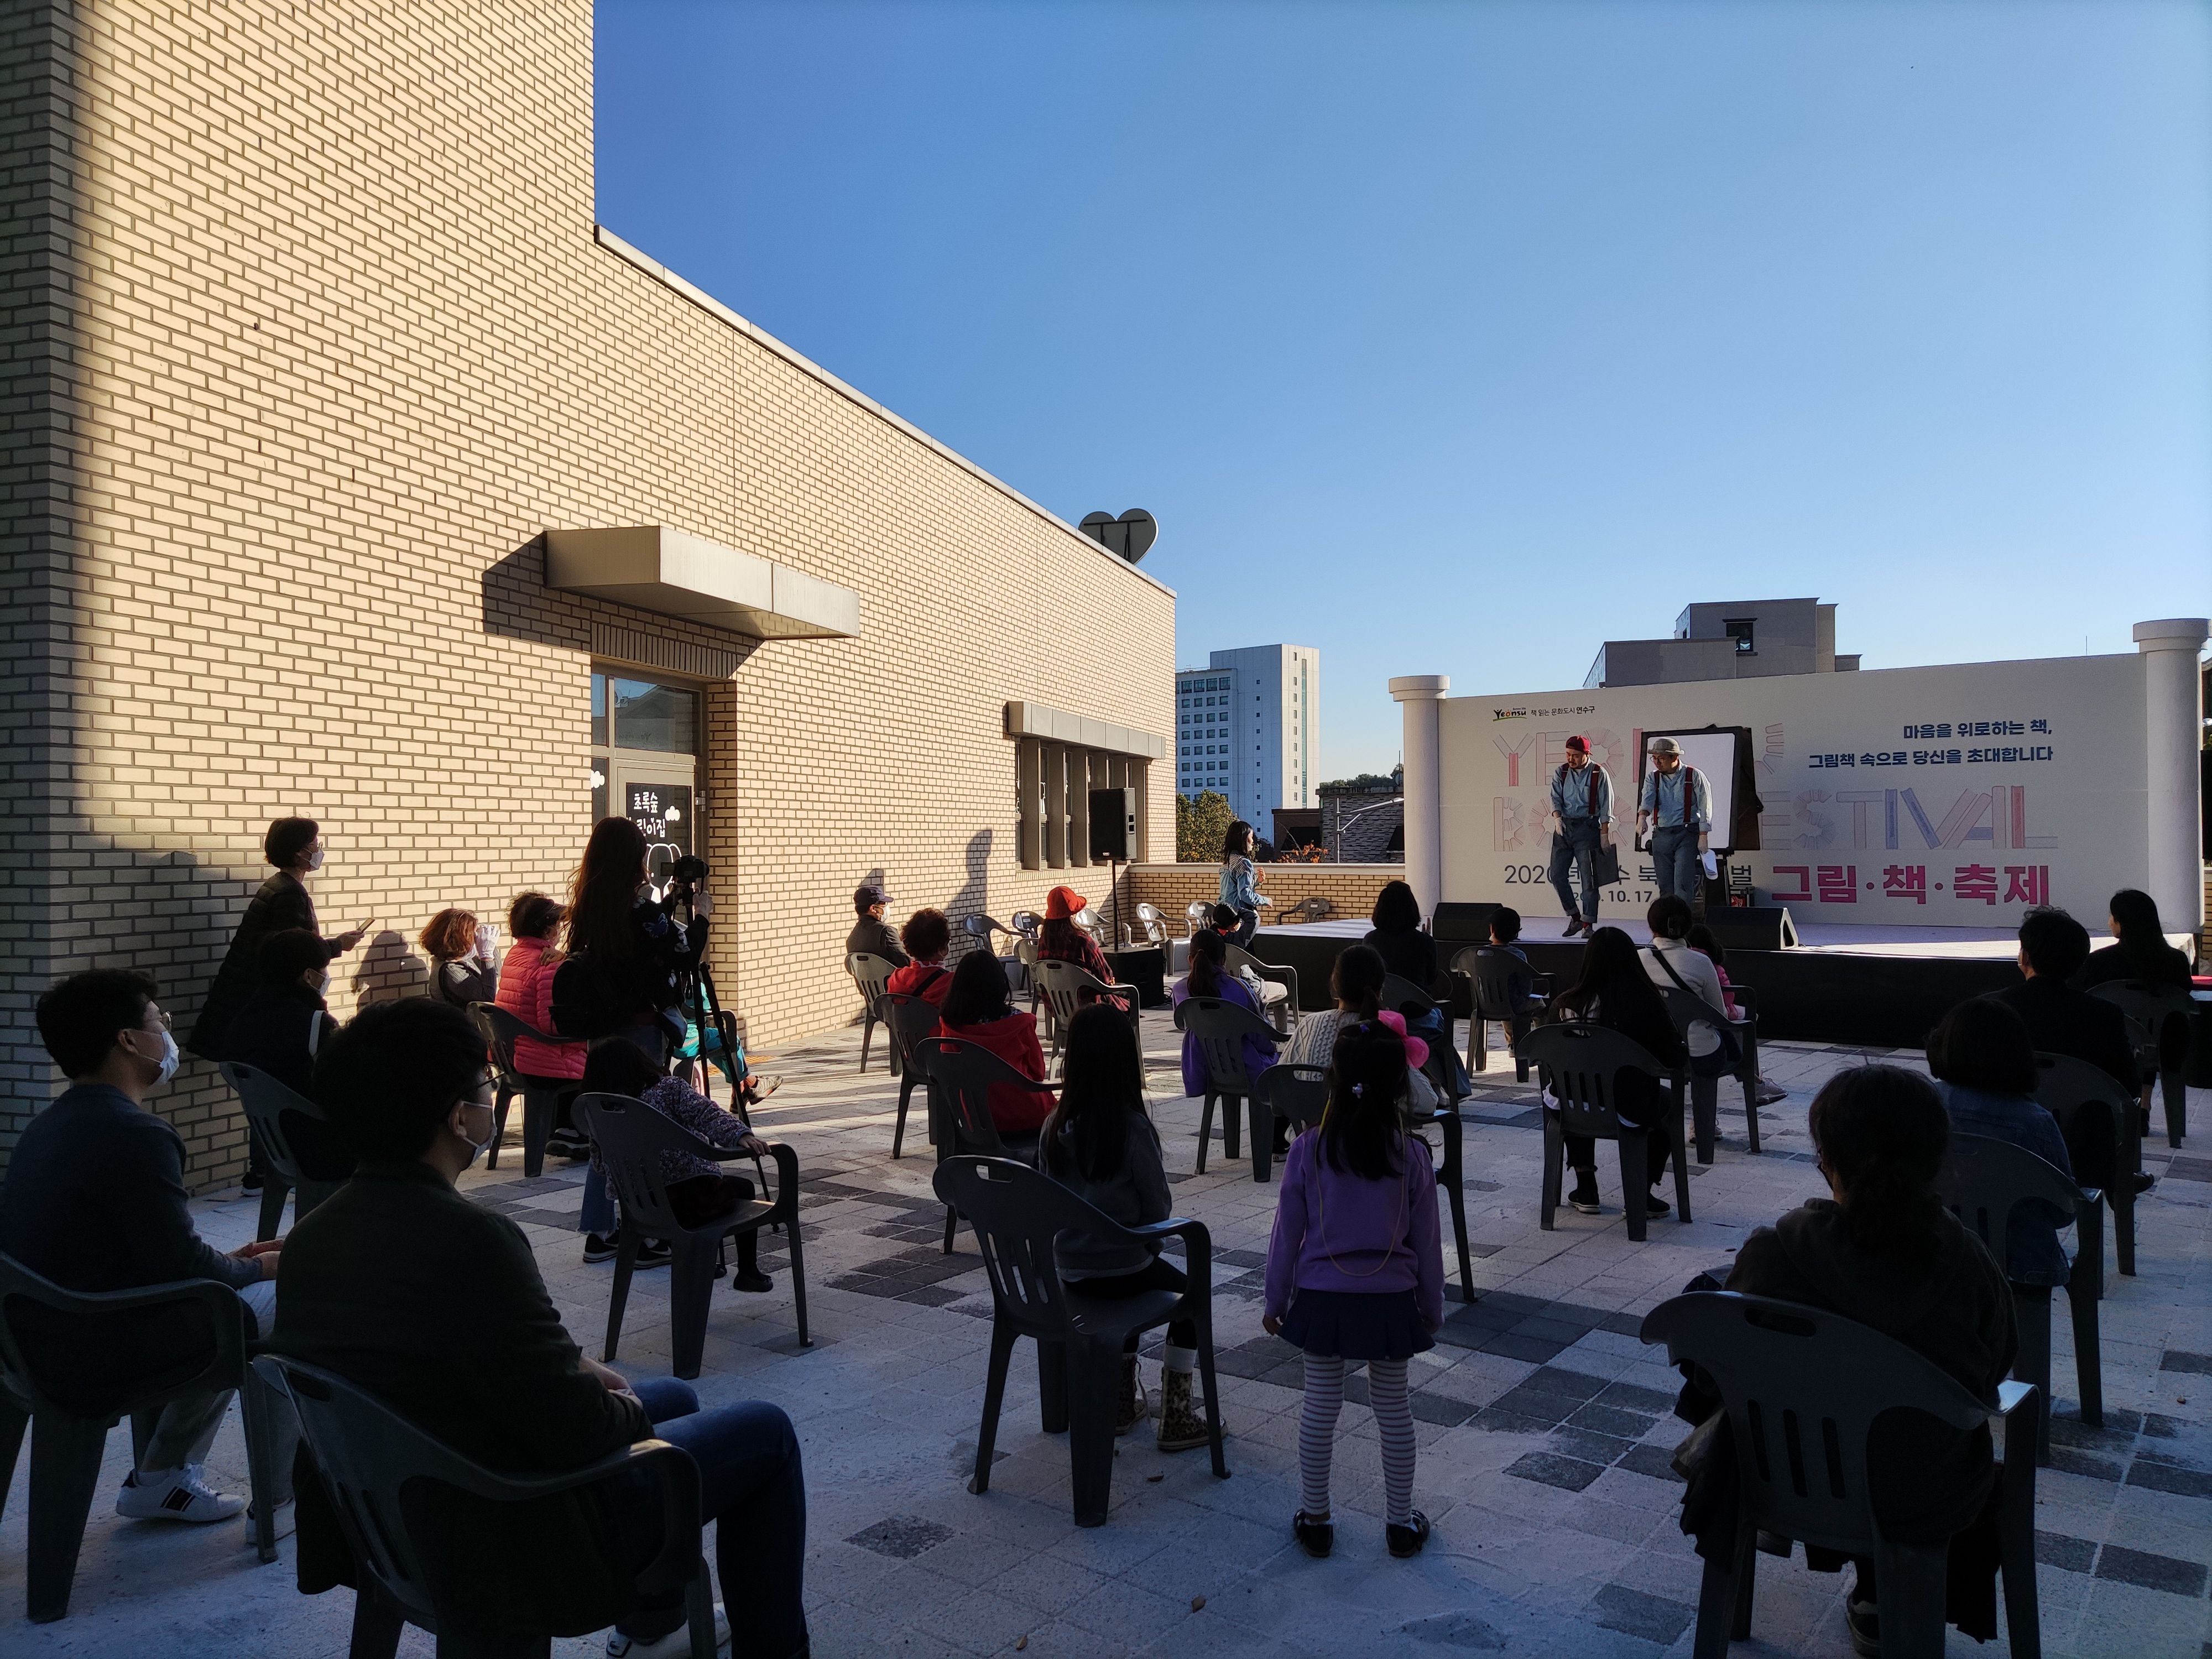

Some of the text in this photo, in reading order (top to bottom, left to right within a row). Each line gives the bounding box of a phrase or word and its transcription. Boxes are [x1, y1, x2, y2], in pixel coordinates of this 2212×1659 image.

[1493, 708, 1526, 720] Yeonsu
[1551, 707, 1575, 716] 문화도시
[1576, 706, 1595, 714] 연수구
[1904, 719, 2052, 739] 마음을 위로하는 책,
[1808, 746, 2053, 768] 그림책 속으로 당신을 초대합니다
[634, 791, 658, 813] 초록숲
[627, 817, 666, 838] 린이집
[1759, 785, 2059, 850] ESTIVAL
